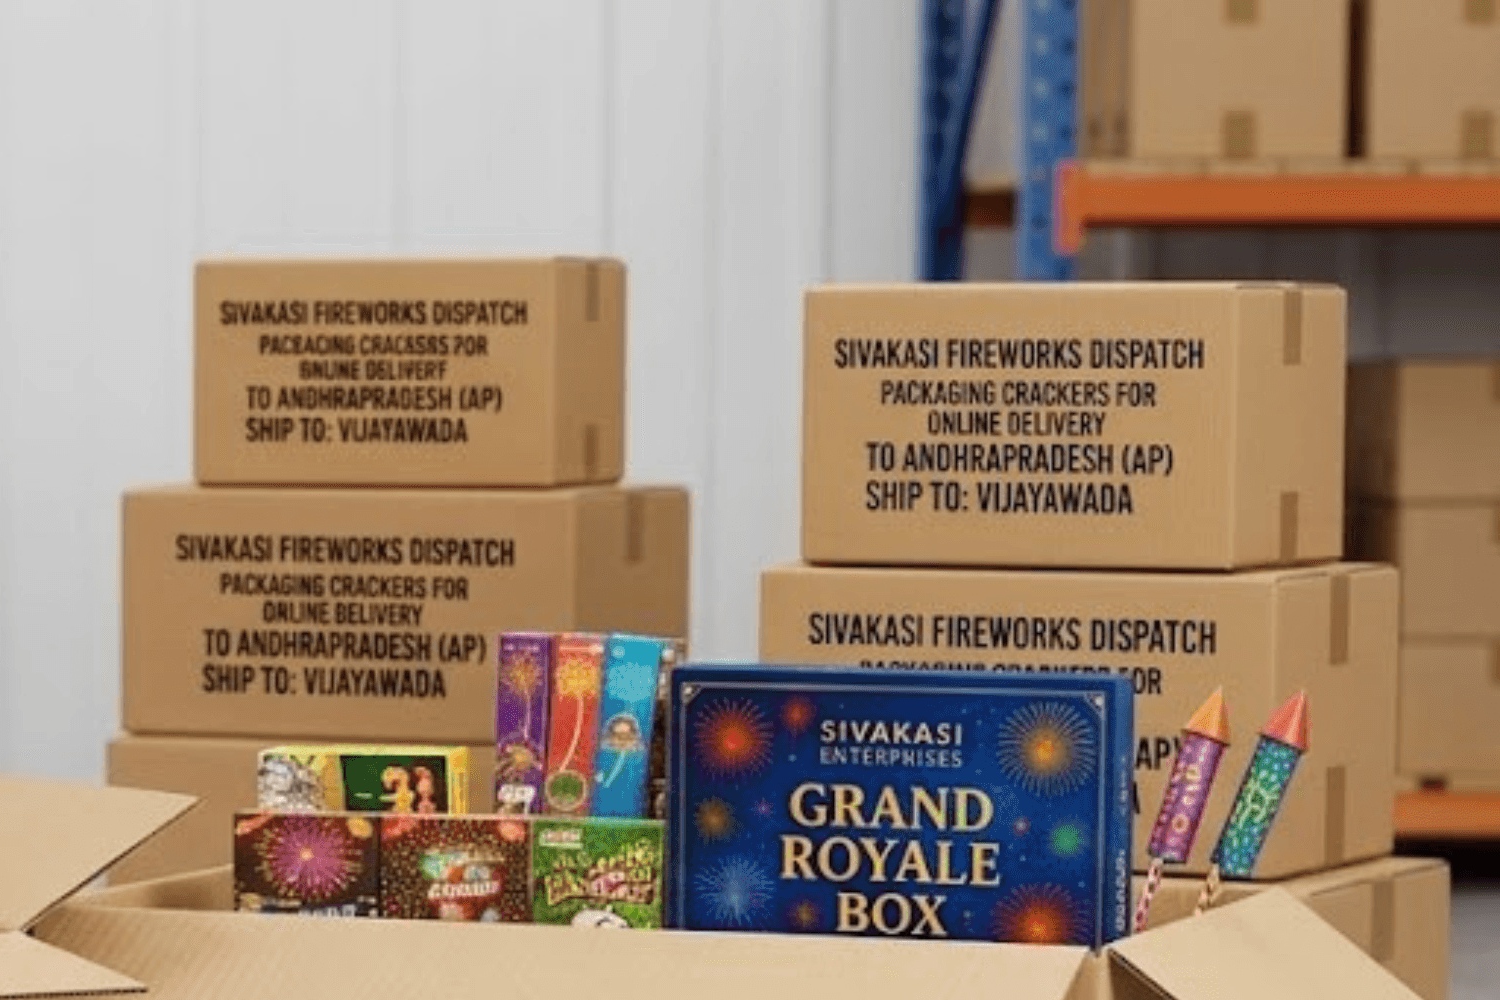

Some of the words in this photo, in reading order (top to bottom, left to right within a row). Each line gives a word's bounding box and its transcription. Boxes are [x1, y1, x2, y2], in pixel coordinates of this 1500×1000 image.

[219, 300, 308, 325] SIVAKASI
[313, 300, 426, 325] FIREWORKS
[432, 300, 528, 325] DISPATCH
[834, 338, 939, 369] SIVAKASI
[946, 338, 1082, 369] FIREWORKS
[1089, 339, 1205, 370] DISPATCH
[245, 386, 272, 410] TO
[458, 385, 504, 413] (AP)
[880, 379, 997, 405] PACKAGING
[1002, 380, 1111, 407] CRACKERS
[1115, 381, 1157, 407] FOR
[245, 418, 294, 443] SHIP
[298, 418, 333, 443] TO:
[927, 410, 1002, 436] ONLINE
[1007, 411, 1107, 437] DELIVERY
[866, 442, 895, 473] TO
[901, 443, 1115, 475] ANDHRAPRADESH
[1121, 444, 1174, 477] (AP)
[865, 480, 923, 512] SHIP
[928, 481, 969, 513] TO:
[975, 482, 1134, 515] VIJAYAWADA
[174, 534, 273, 563] SIVAKASI
[279, 536, 403, 565] FIREWORKS
[409, 537, 515, 567] DISPATCH
[219, 572, 326, 598] PACKAGING
[330, 575, 426, 599] CRACKERS
[432, 577, 469, 600] FOR
[202, 629, 231, 657] TO
[236, 630, 432, 661] ANDHRAPRADESH
[437, 632, 488, 665] (AP)
[808, 612, 924, 647] SIVAKASI
[931, 615, 1082, 652] FIREWORKS
[1089, 618, 1218, 655] DISPATCH
[202, 664, 256, 695] SHIP
[260, 666, 297, 695] TO:
[819, 720, 963, 746] SIVAKASI
[788, 781, 995, 833] GRAND
[780, 836, 1001, 888] ROYALE
[836, 892, 949, 938] BOX
